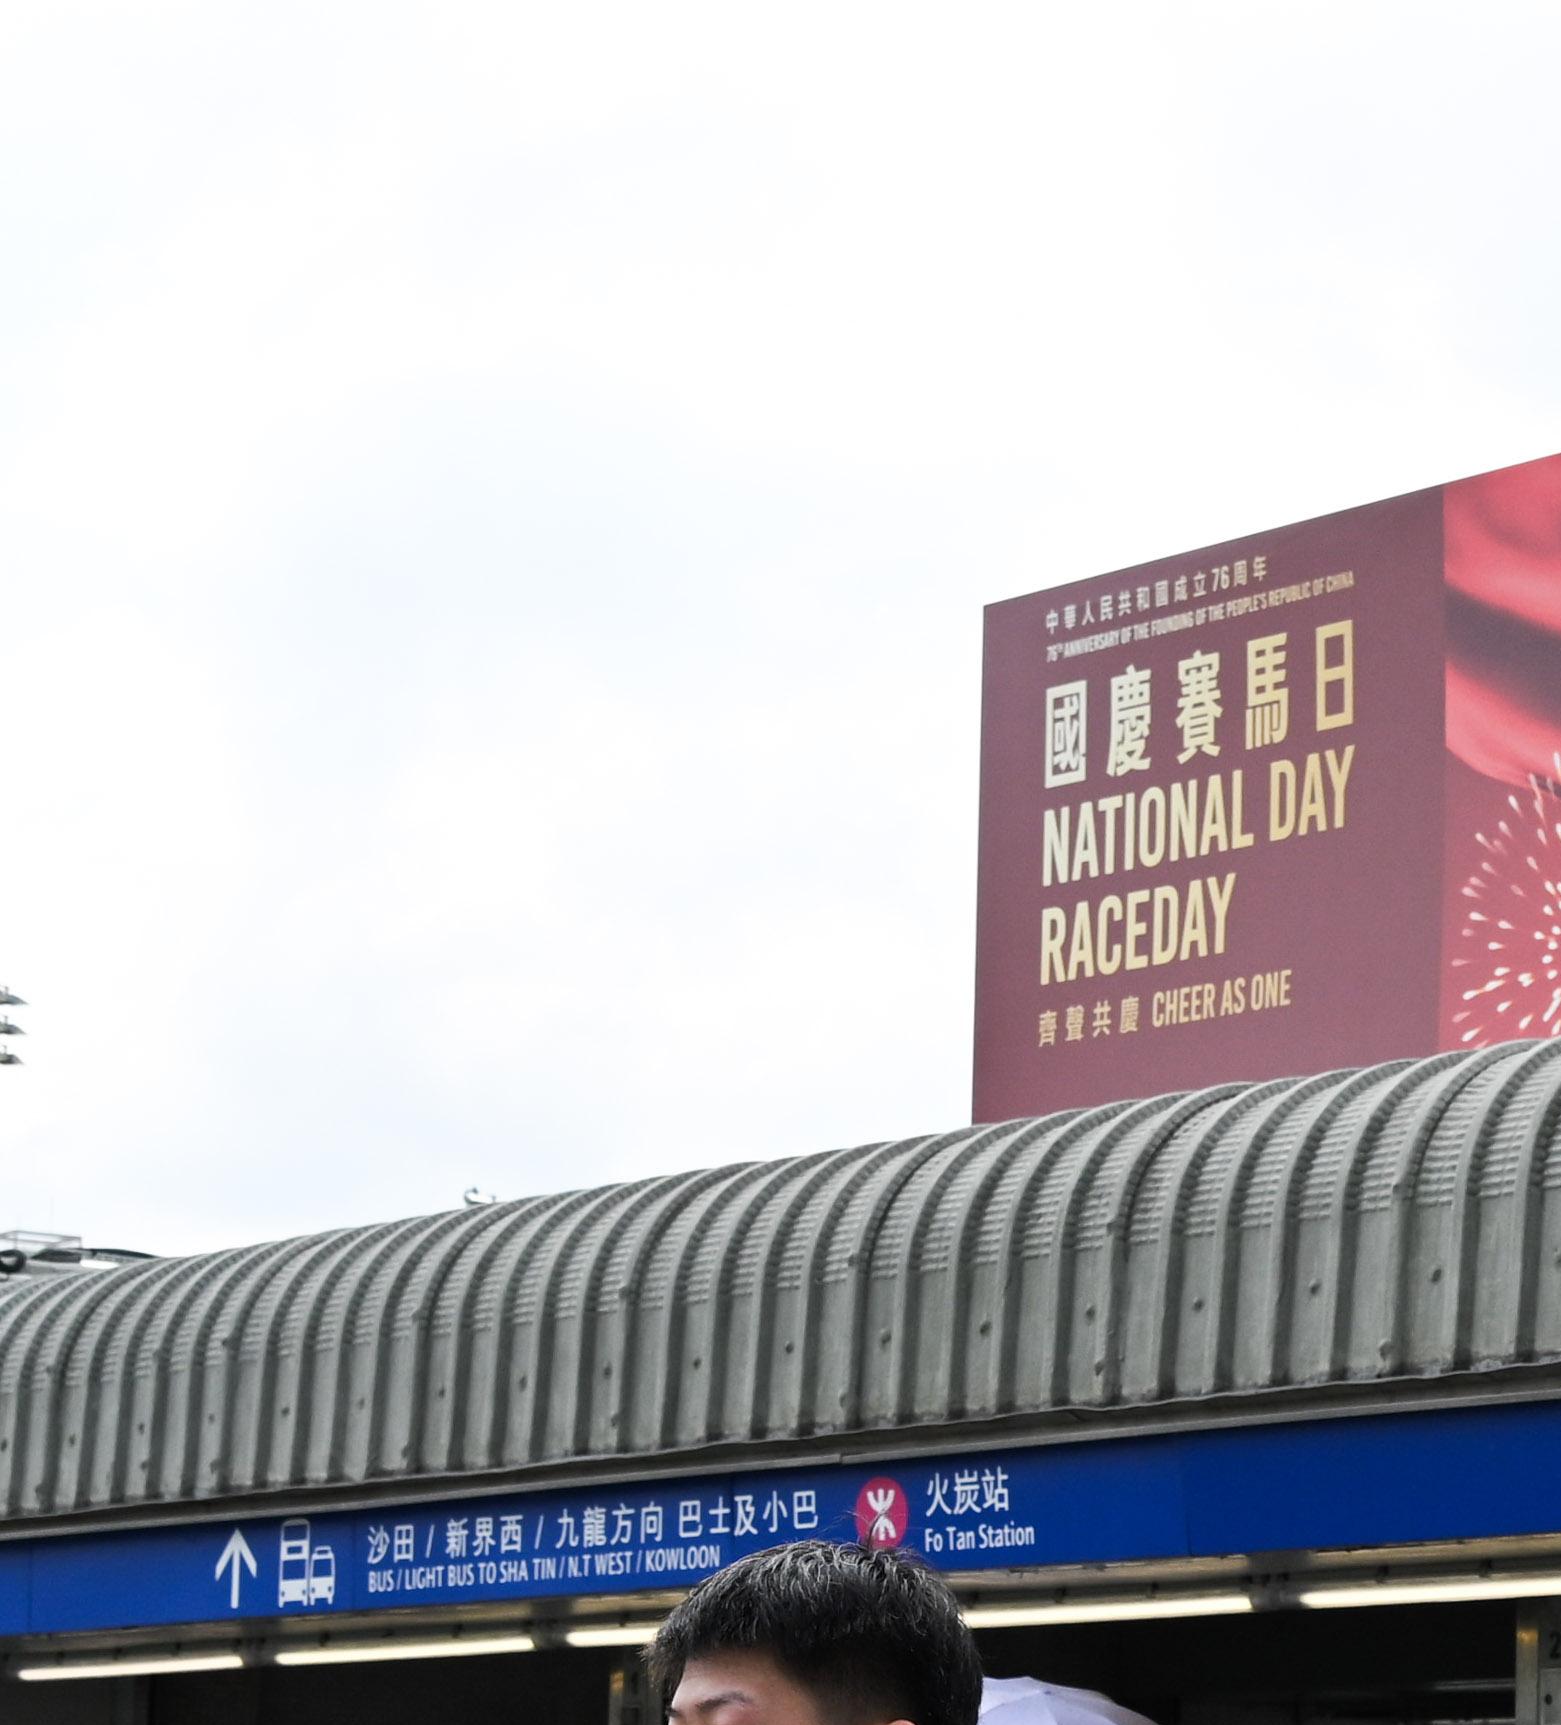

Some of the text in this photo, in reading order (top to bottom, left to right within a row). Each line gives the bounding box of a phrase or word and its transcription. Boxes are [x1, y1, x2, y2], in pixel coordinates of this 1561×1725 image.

[1045, 618, 1353, 788] 國慶賽馬日
[1042, 745, 1355, 886] NATIONAL DAY
[1040, 873, 1236, 985] RACEDAY
[1038, 969, 1292, 1047] 齊聲共慶 CHEER AS ONE
[367, 1524, 414, 1564] 沙田
[446, 1515, 523, 1559] 新界西
[555, 1501, 663, 1550] 九龍方向
[679, 1490, 818, 1538] 巴士及小巴
[925, 1466, 1009, 1517] 火炭站
[368, 1569, 393, 1593] BUS
[405, 1566, 444, 1590] LIGHT
[448, 1563, 475, 1587] BUS
[479, 1561, 497, 1584] TO
[500, 1558, 529, 1583] SHA
[533, 1557, 556, 1580] TIN
[567, 1554, 592, 1578] N.T
[595, 1551, 633, 1575] WEST
[645, 1543, 720, 1573] KOWLOON
[925, 1520, 1035, 1552] Fo Tan Station
[1549, 1631, 1561, 1659] 2
